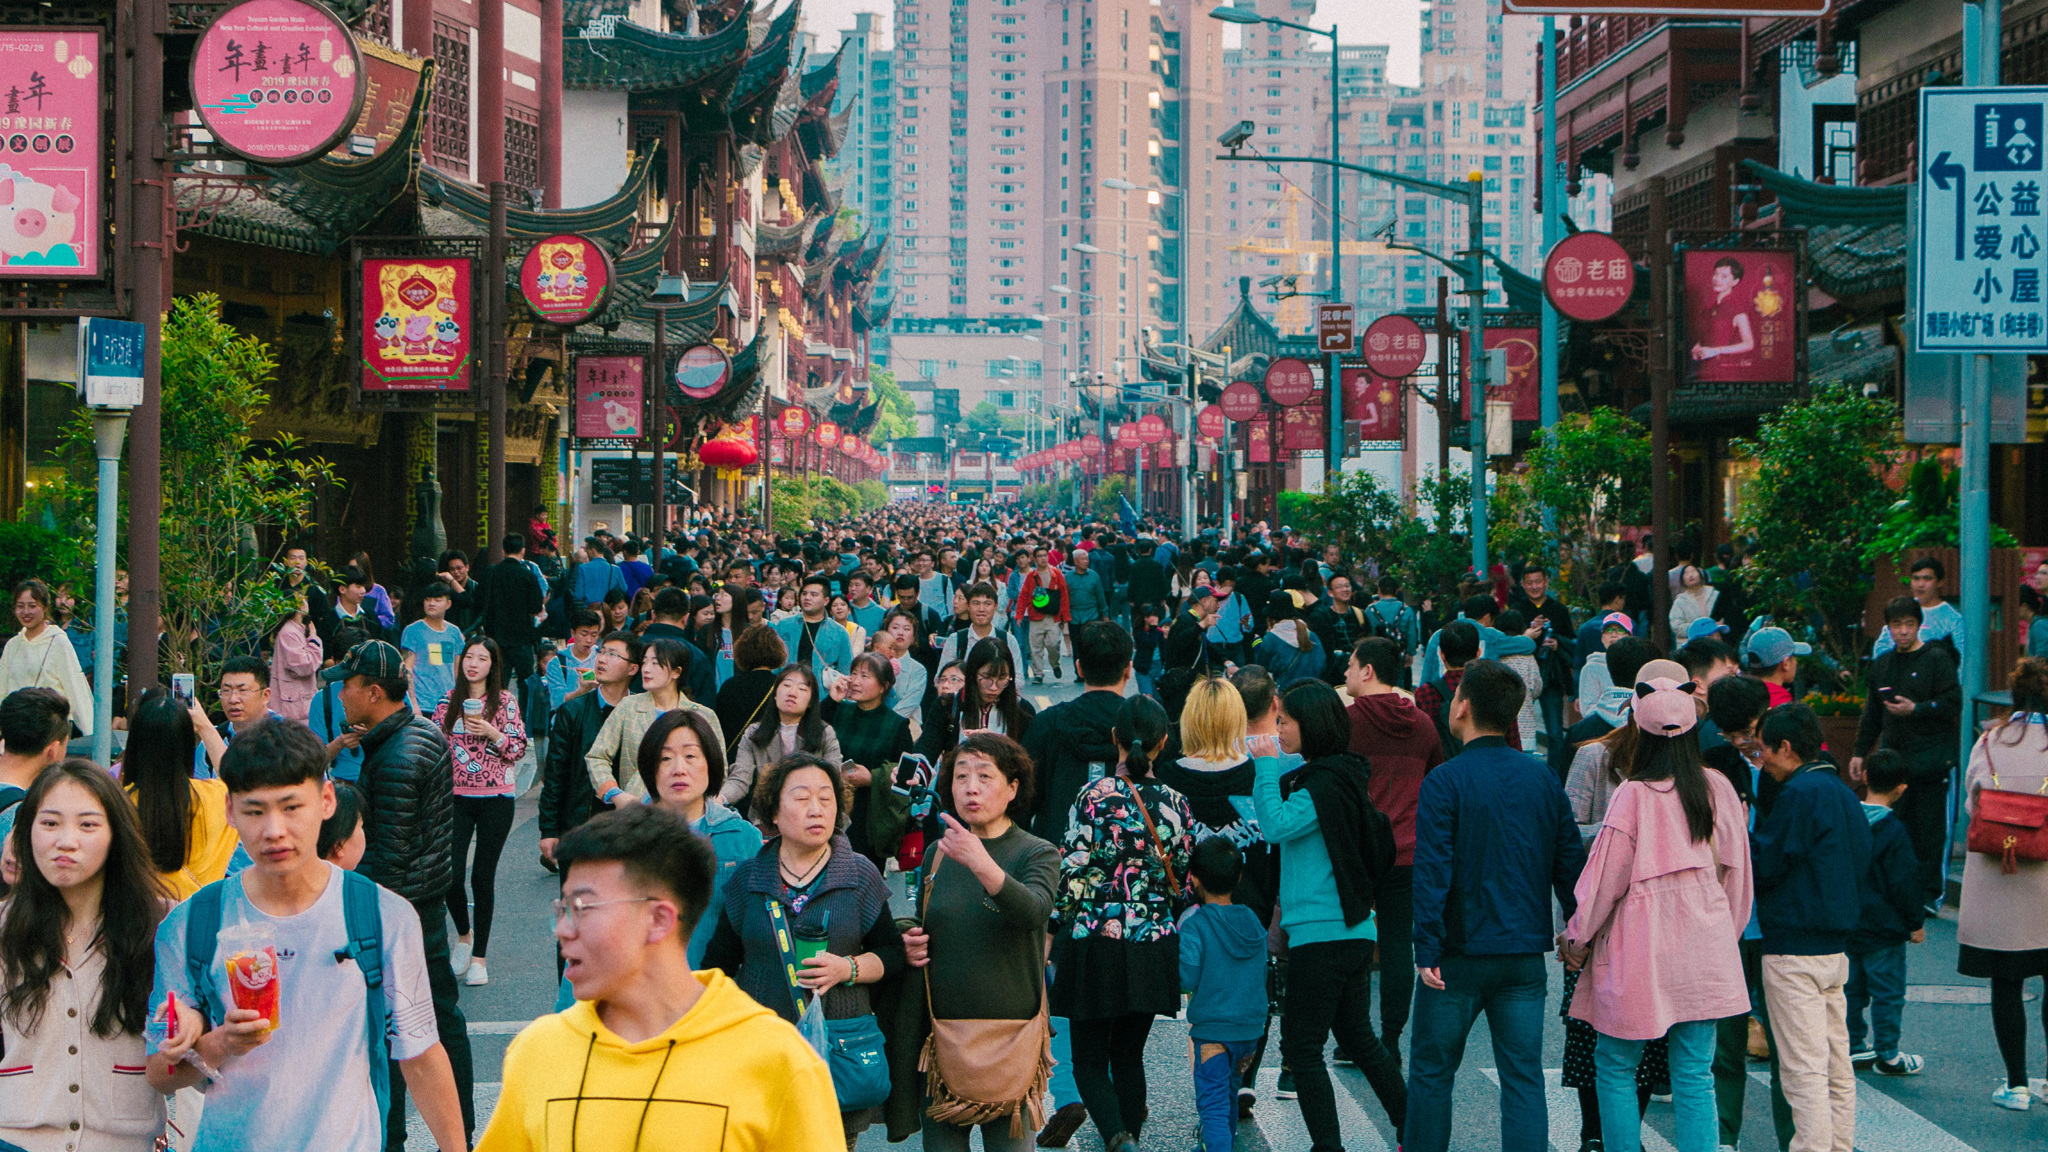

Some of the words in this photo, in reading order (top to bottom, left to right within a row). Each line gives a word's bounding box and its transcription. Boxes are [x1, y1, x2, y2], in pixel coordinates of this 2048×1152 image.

[262, 77, 285, 87] 2019
[1973, 180, 2041, 217] 公益
[1973, 223, 2041, 261] 爱心
[1587, 258, 1627, 281] 老庙
[1973, 267, 2041, 304] 小屋
[1392, 333, 1420, 350] 老庙
